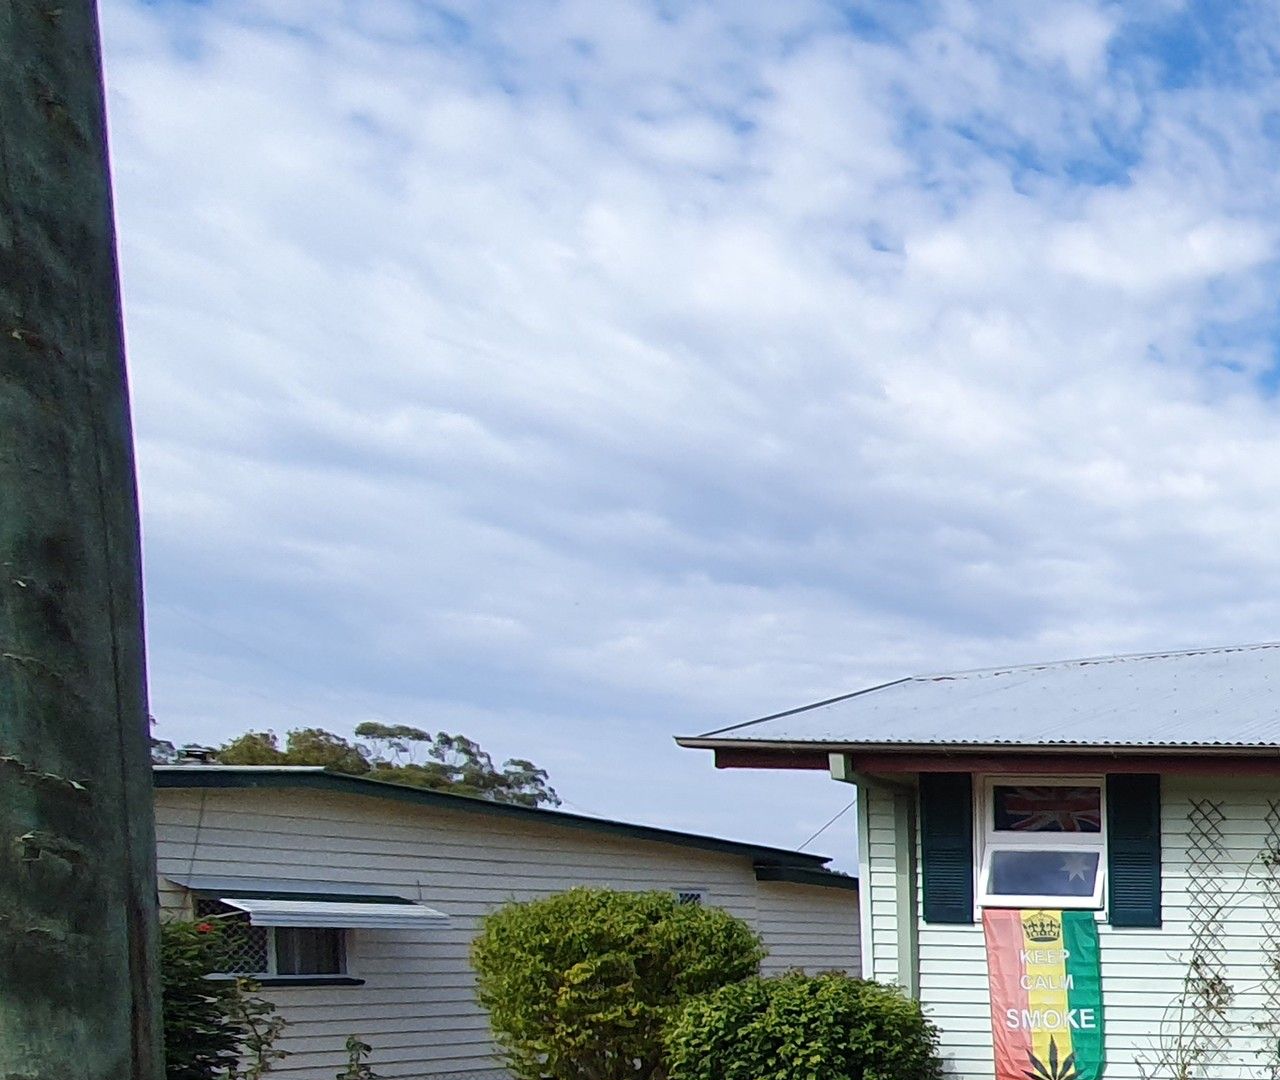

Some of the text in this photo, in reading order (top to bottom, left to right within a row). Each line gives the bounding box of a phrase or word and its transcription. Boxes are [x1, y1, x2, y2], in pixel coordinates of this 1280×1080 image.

[1019, 949, 1070, 965] KEEP
[1020, 974, 1074, 990] CALM
[1006, 1008, 1096, 1030] SMOKE
